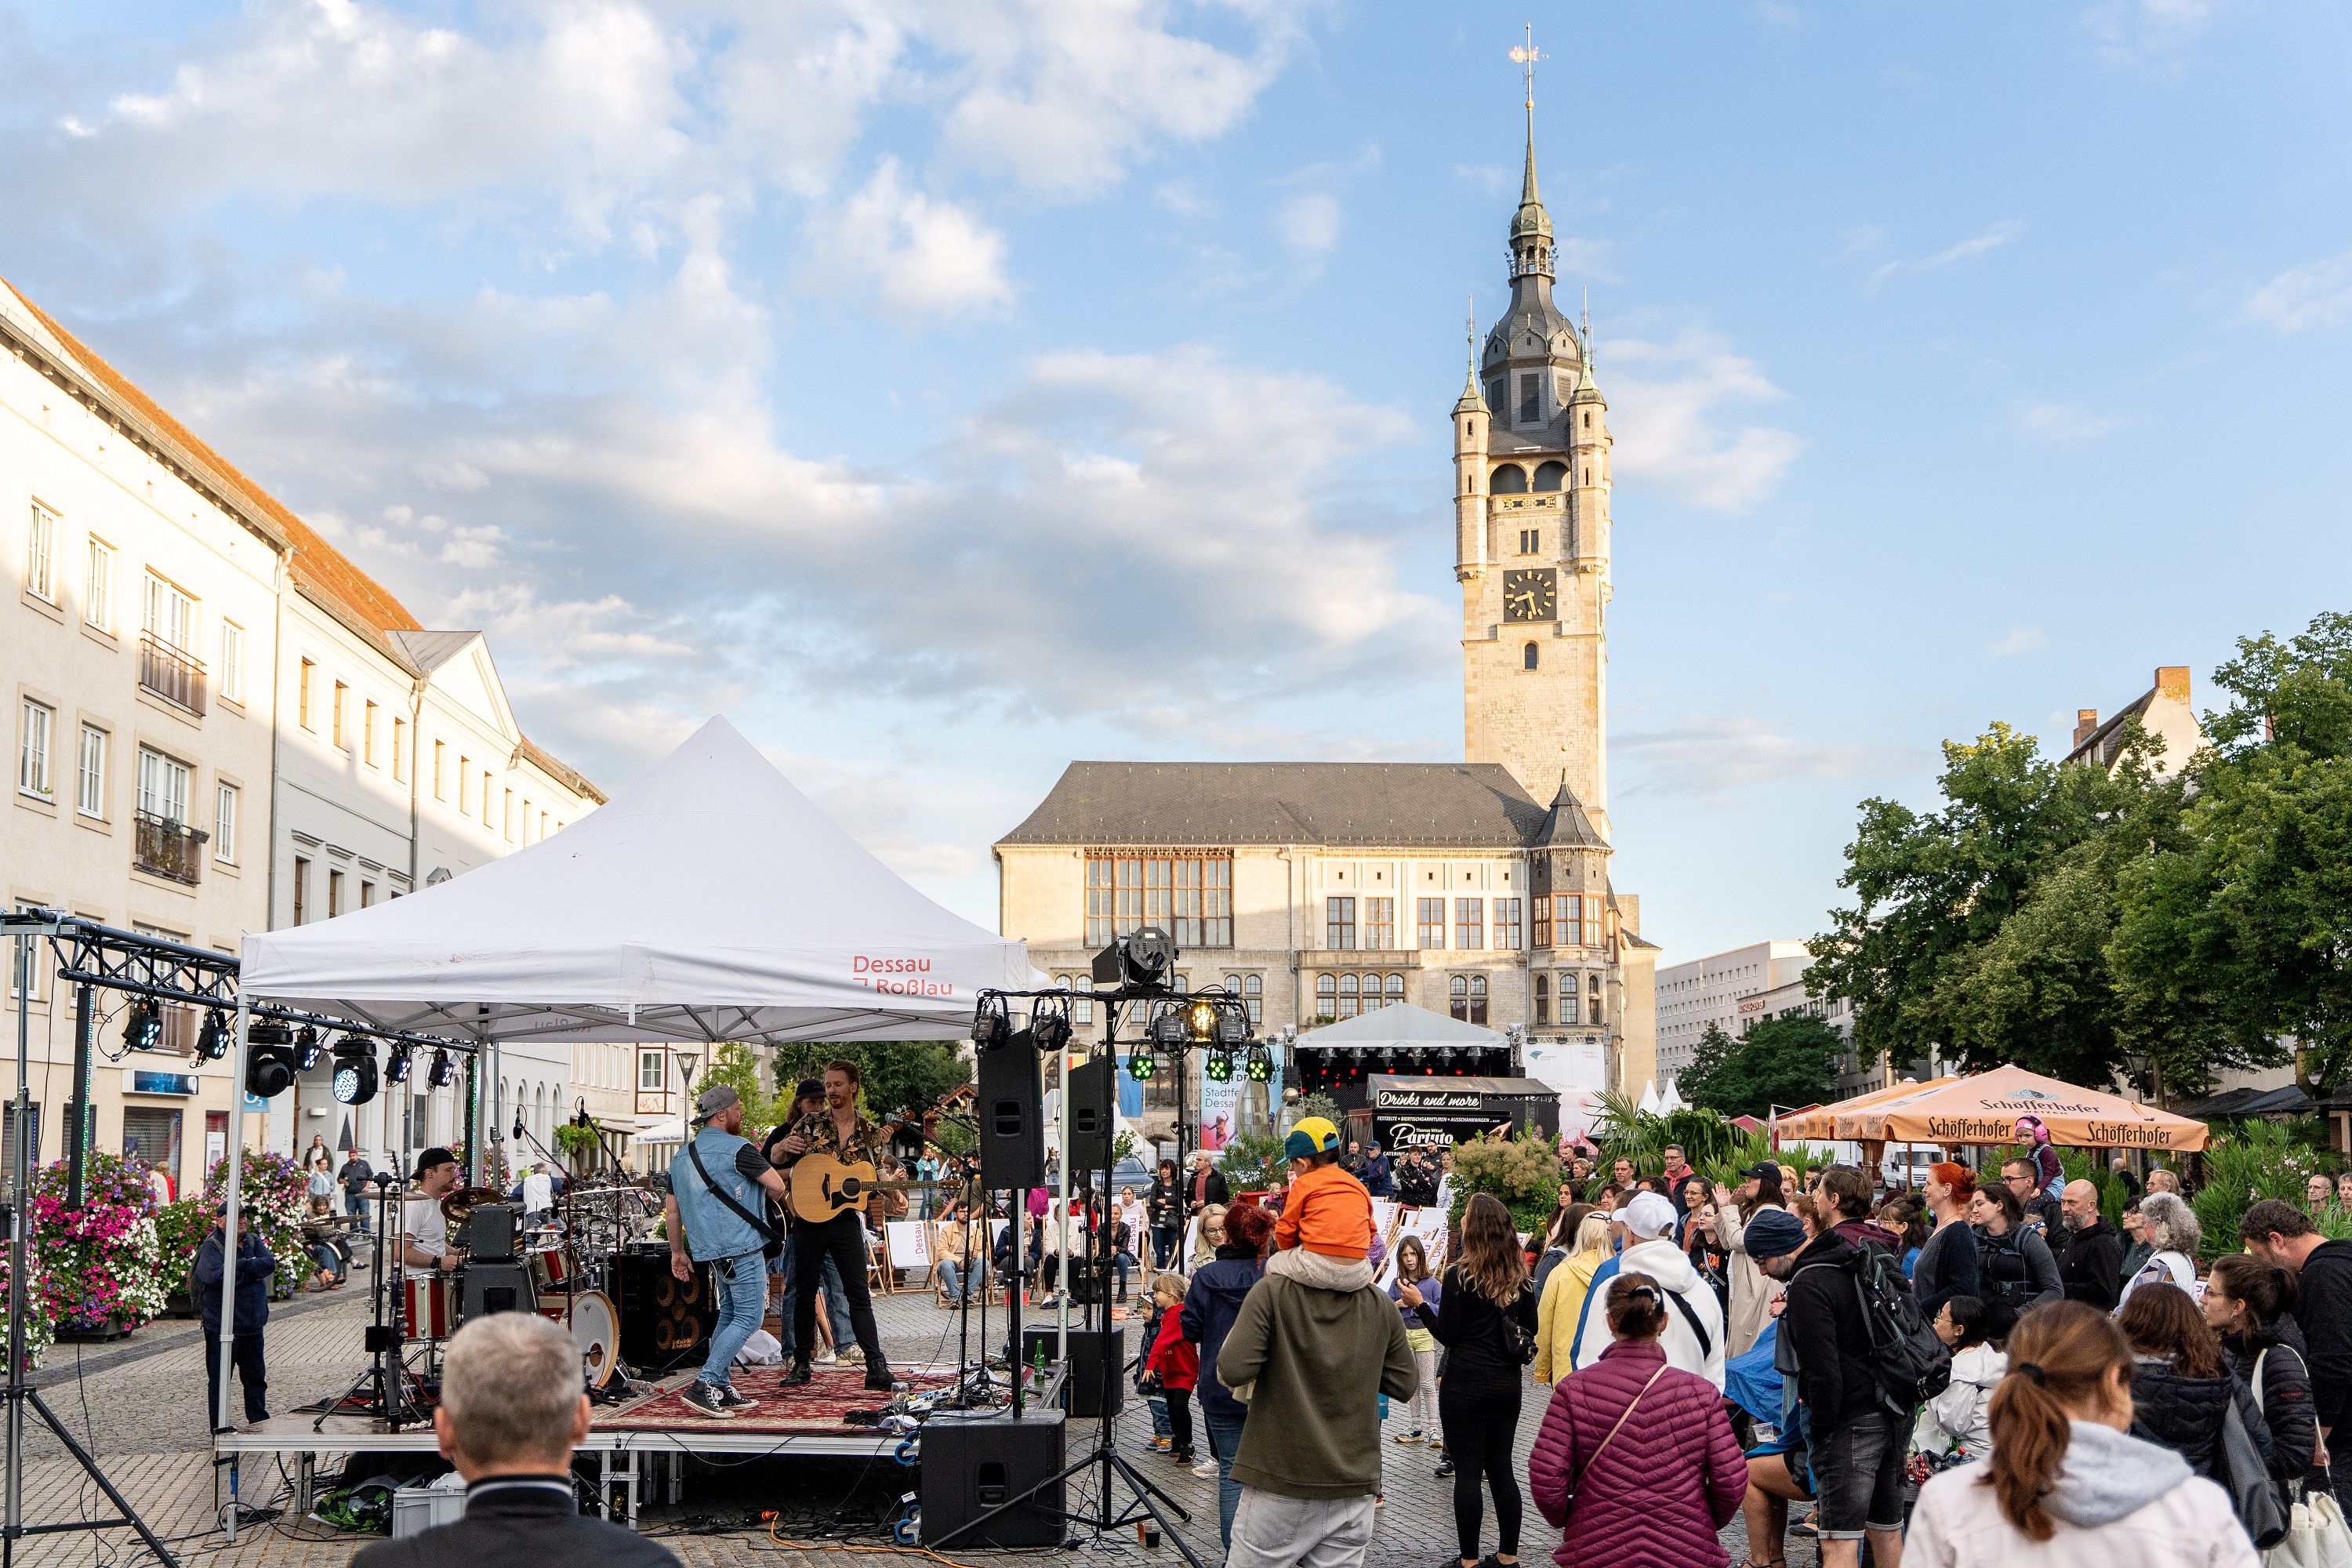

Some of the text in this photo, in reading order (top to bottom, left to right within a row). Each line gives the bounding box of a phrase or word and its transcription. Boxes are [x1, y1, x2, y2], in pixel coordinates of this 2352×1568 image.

[854, 956, 931, 973] Dessau
[877, 978, 953, 996] Roßlau
[1206, 1087, 1240, 1097] Stadtfe
[1380, 1091, 1479, 1106] Drinks and more
[1205, 1098, 1236, 1108] Dessa
[1980, 1099, 2100, 1113] Schöfferhofer
[1927, 1116, 2012, 1139] Schöfferhofer
[2086, 1120, 2172, 1145] Schöfferhofer
[1381, 1206, 1395, 1235] Dessau
[915, 1224, 924, 1254] Dessau
[1127, 1218, 1137, 1252] Dessau
